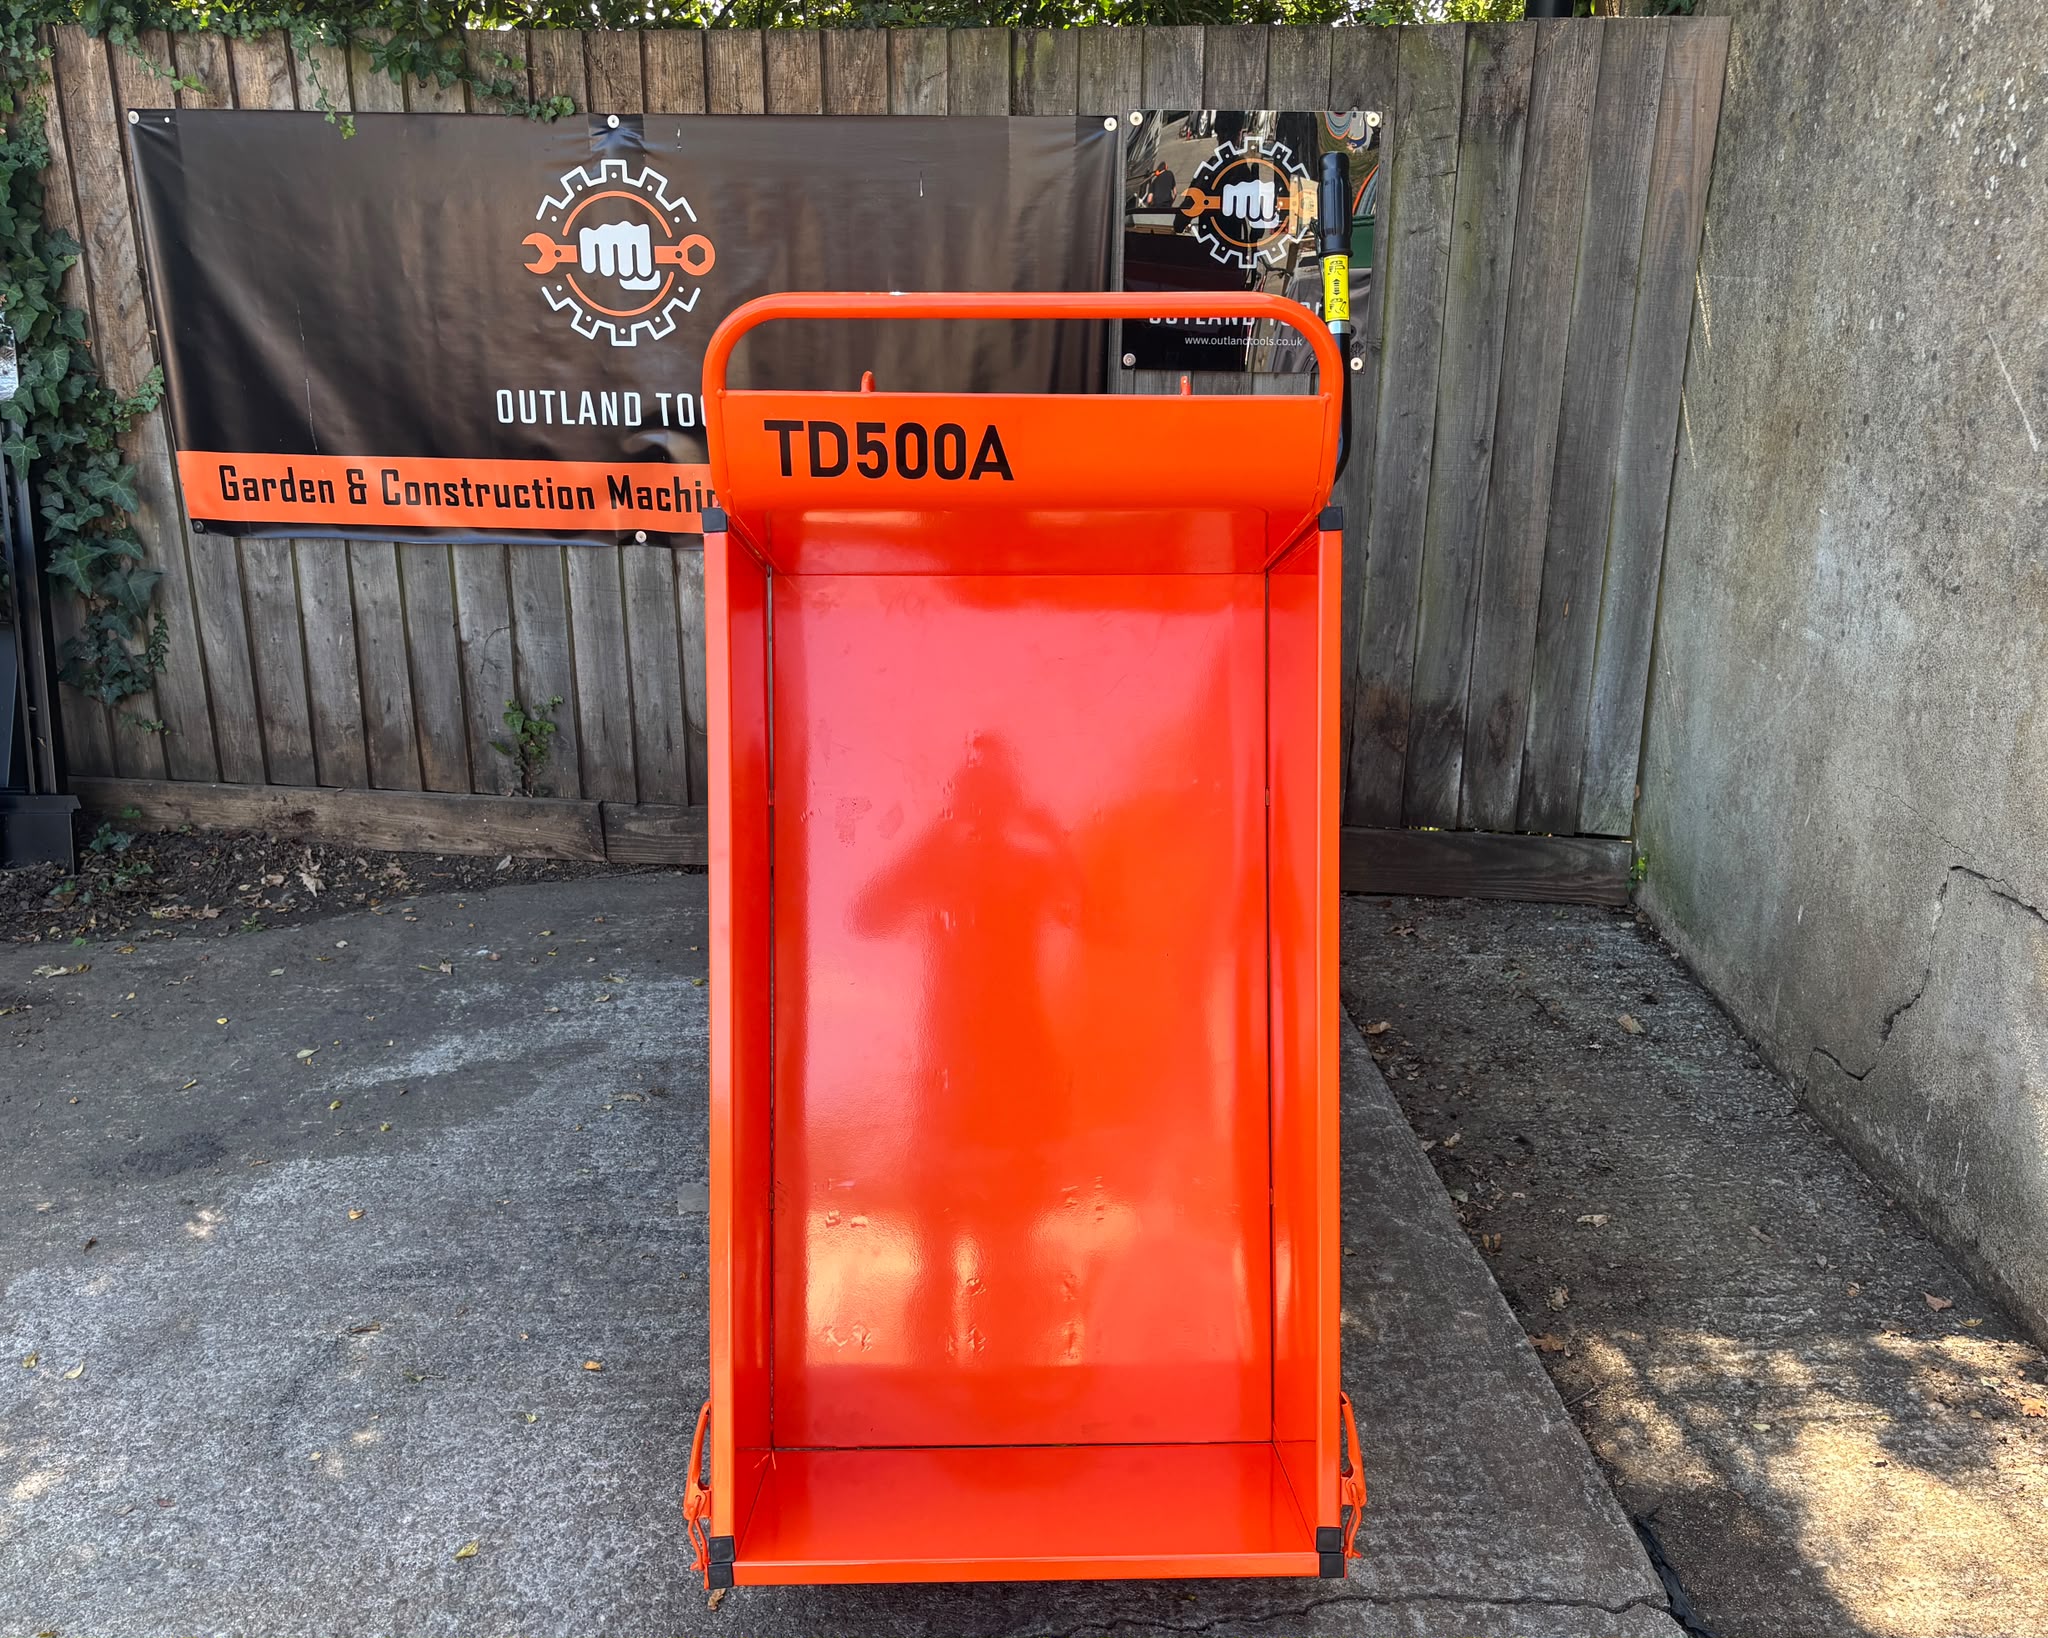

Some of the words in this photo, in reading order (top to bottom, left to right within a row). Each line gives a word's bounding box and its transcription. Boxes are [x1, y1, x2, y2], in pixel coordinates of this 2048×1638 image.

[1184, 335, 1303, 347] www.outlandtools.co.uk
[496, 389, 642, 427] OUTLAND
[655, 392, 707, 428] TO
[763, 419, 1015, 481] TD500A
[218, 464, 335, 504] Garden
[346, 468, 367, 505] &
[381, 468, 596, 511] Construction
